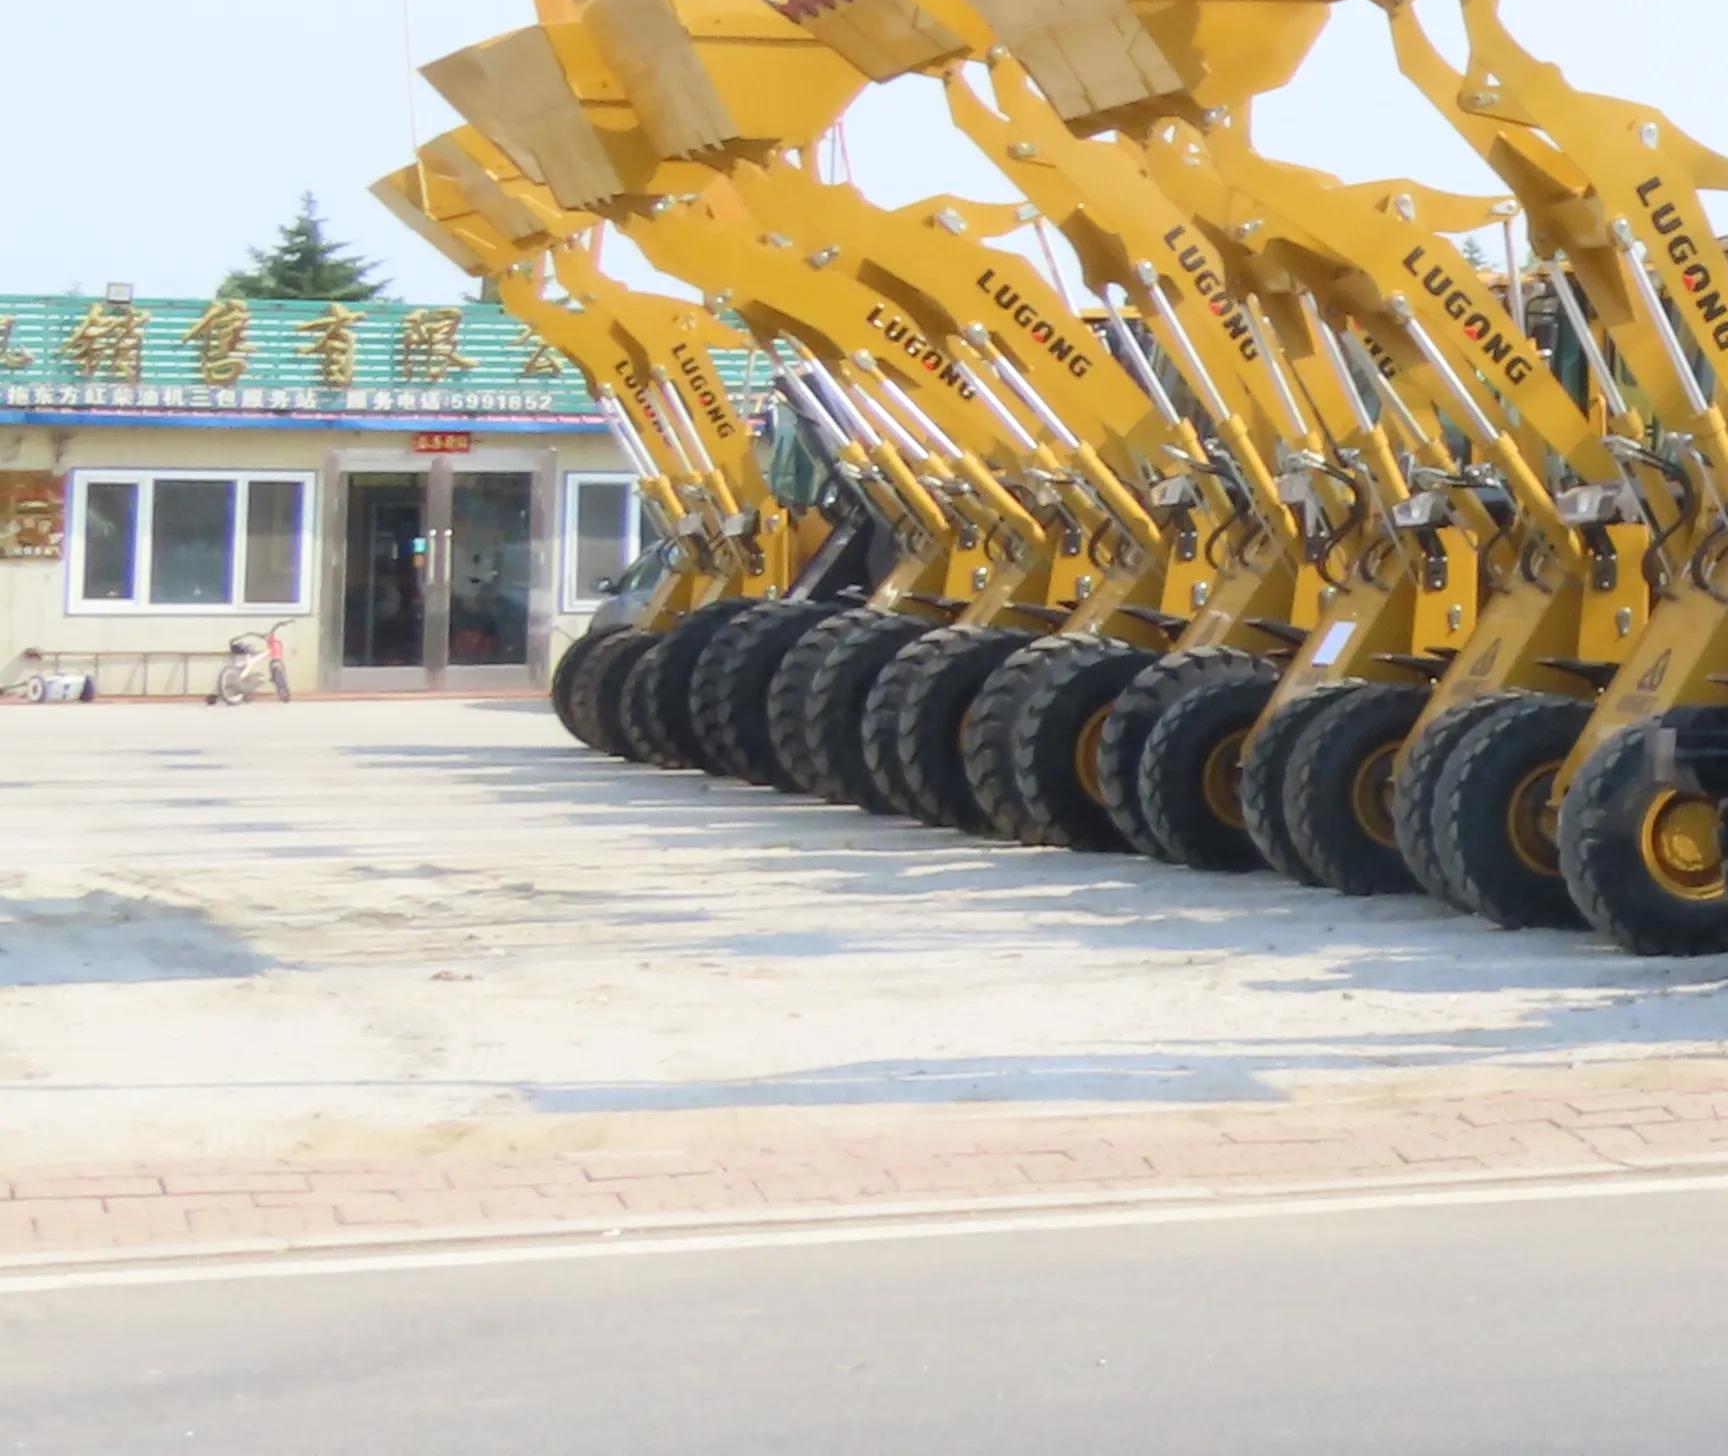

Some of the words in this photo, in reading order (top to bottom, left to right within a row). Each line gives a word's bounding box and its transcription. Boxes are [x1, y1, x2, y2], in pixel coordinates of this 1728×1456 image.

[976, 269, 1093, 378] LUGONG
[1164, 225, 1260, 362] LUGONG
[1402, 246, 1532, 385] LUGONG
[671, 343, 735, 439] LUGONG
[866, 302, 978, 401] LUGONG
